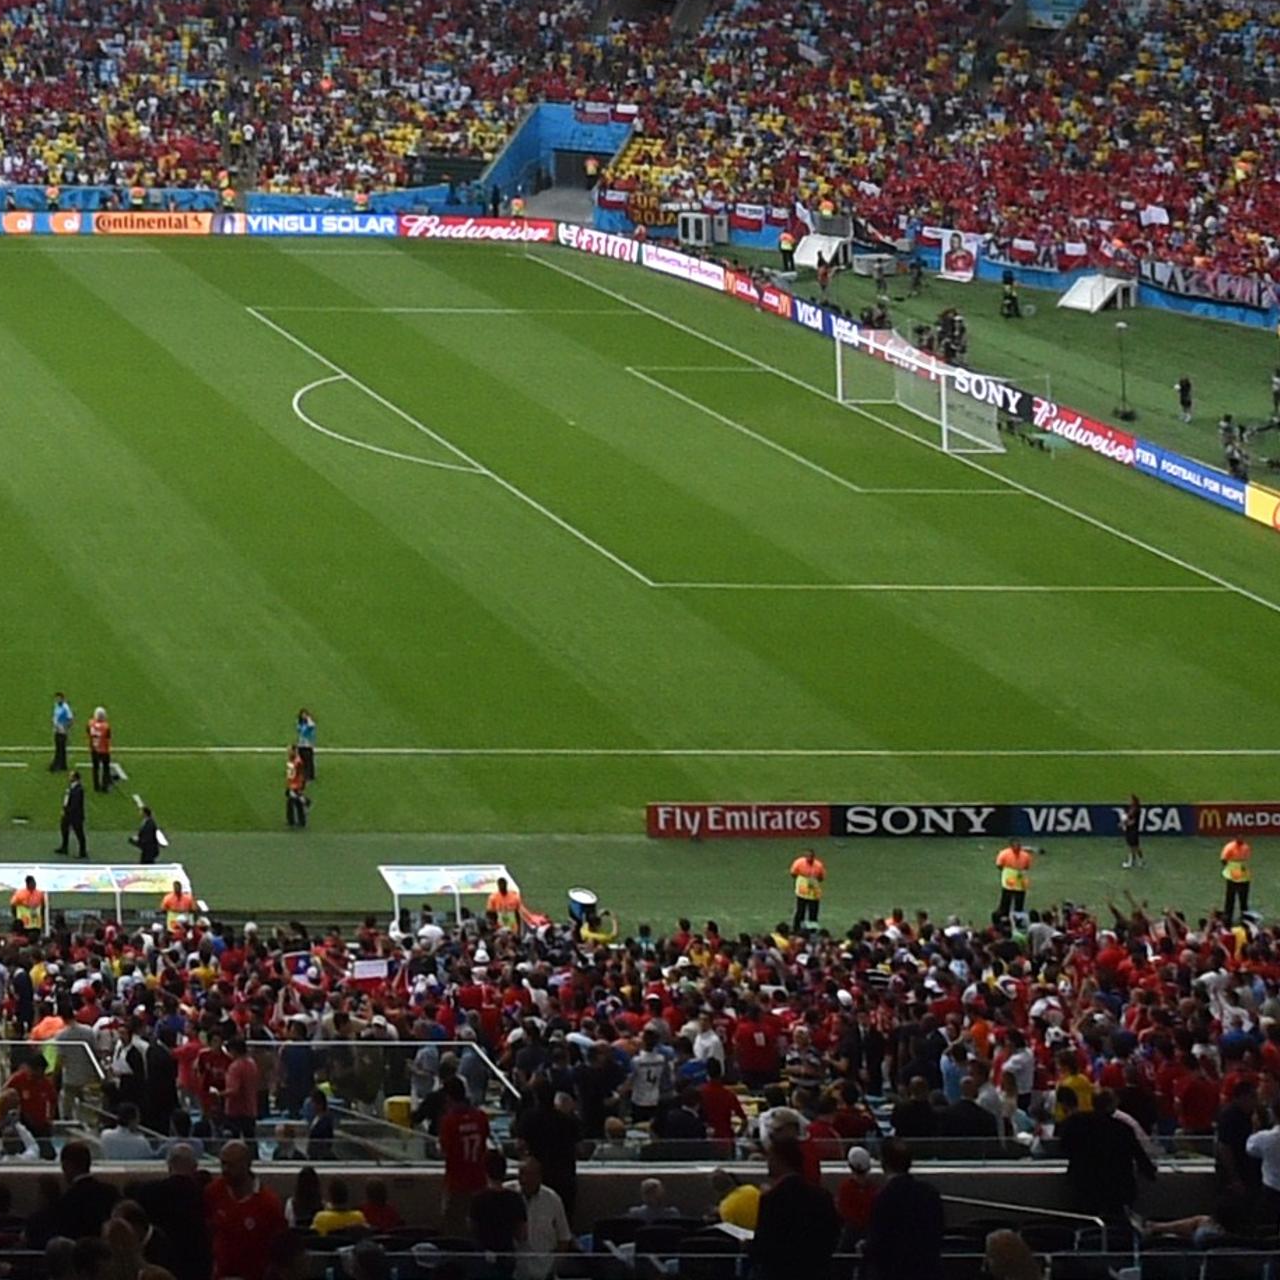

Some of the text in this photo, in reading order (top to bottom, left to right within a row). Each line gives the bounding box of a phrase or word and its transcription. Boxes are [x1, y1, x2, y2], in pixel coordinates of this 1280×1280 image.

[95, 213, 190, 232] Continental
[321, 216, 396, 233] SOLAR
[401, 215, 551, 241] Budweiser
[795, 300, 823, 332] VISA
[829, 314, 860, 348] VISA
[954, 367, 1022, 414] SONY
[1032, 397, 1136, 465] Budweiser
[1160, 457, 1203, 488] FOOTBALL
[1203, 477, 1221, 494] FOR
[656, 805, 822, 836] Fly Emirates
[847, 806, 995, 833] SONY
[1020, 806, 1093, 833] VISA
